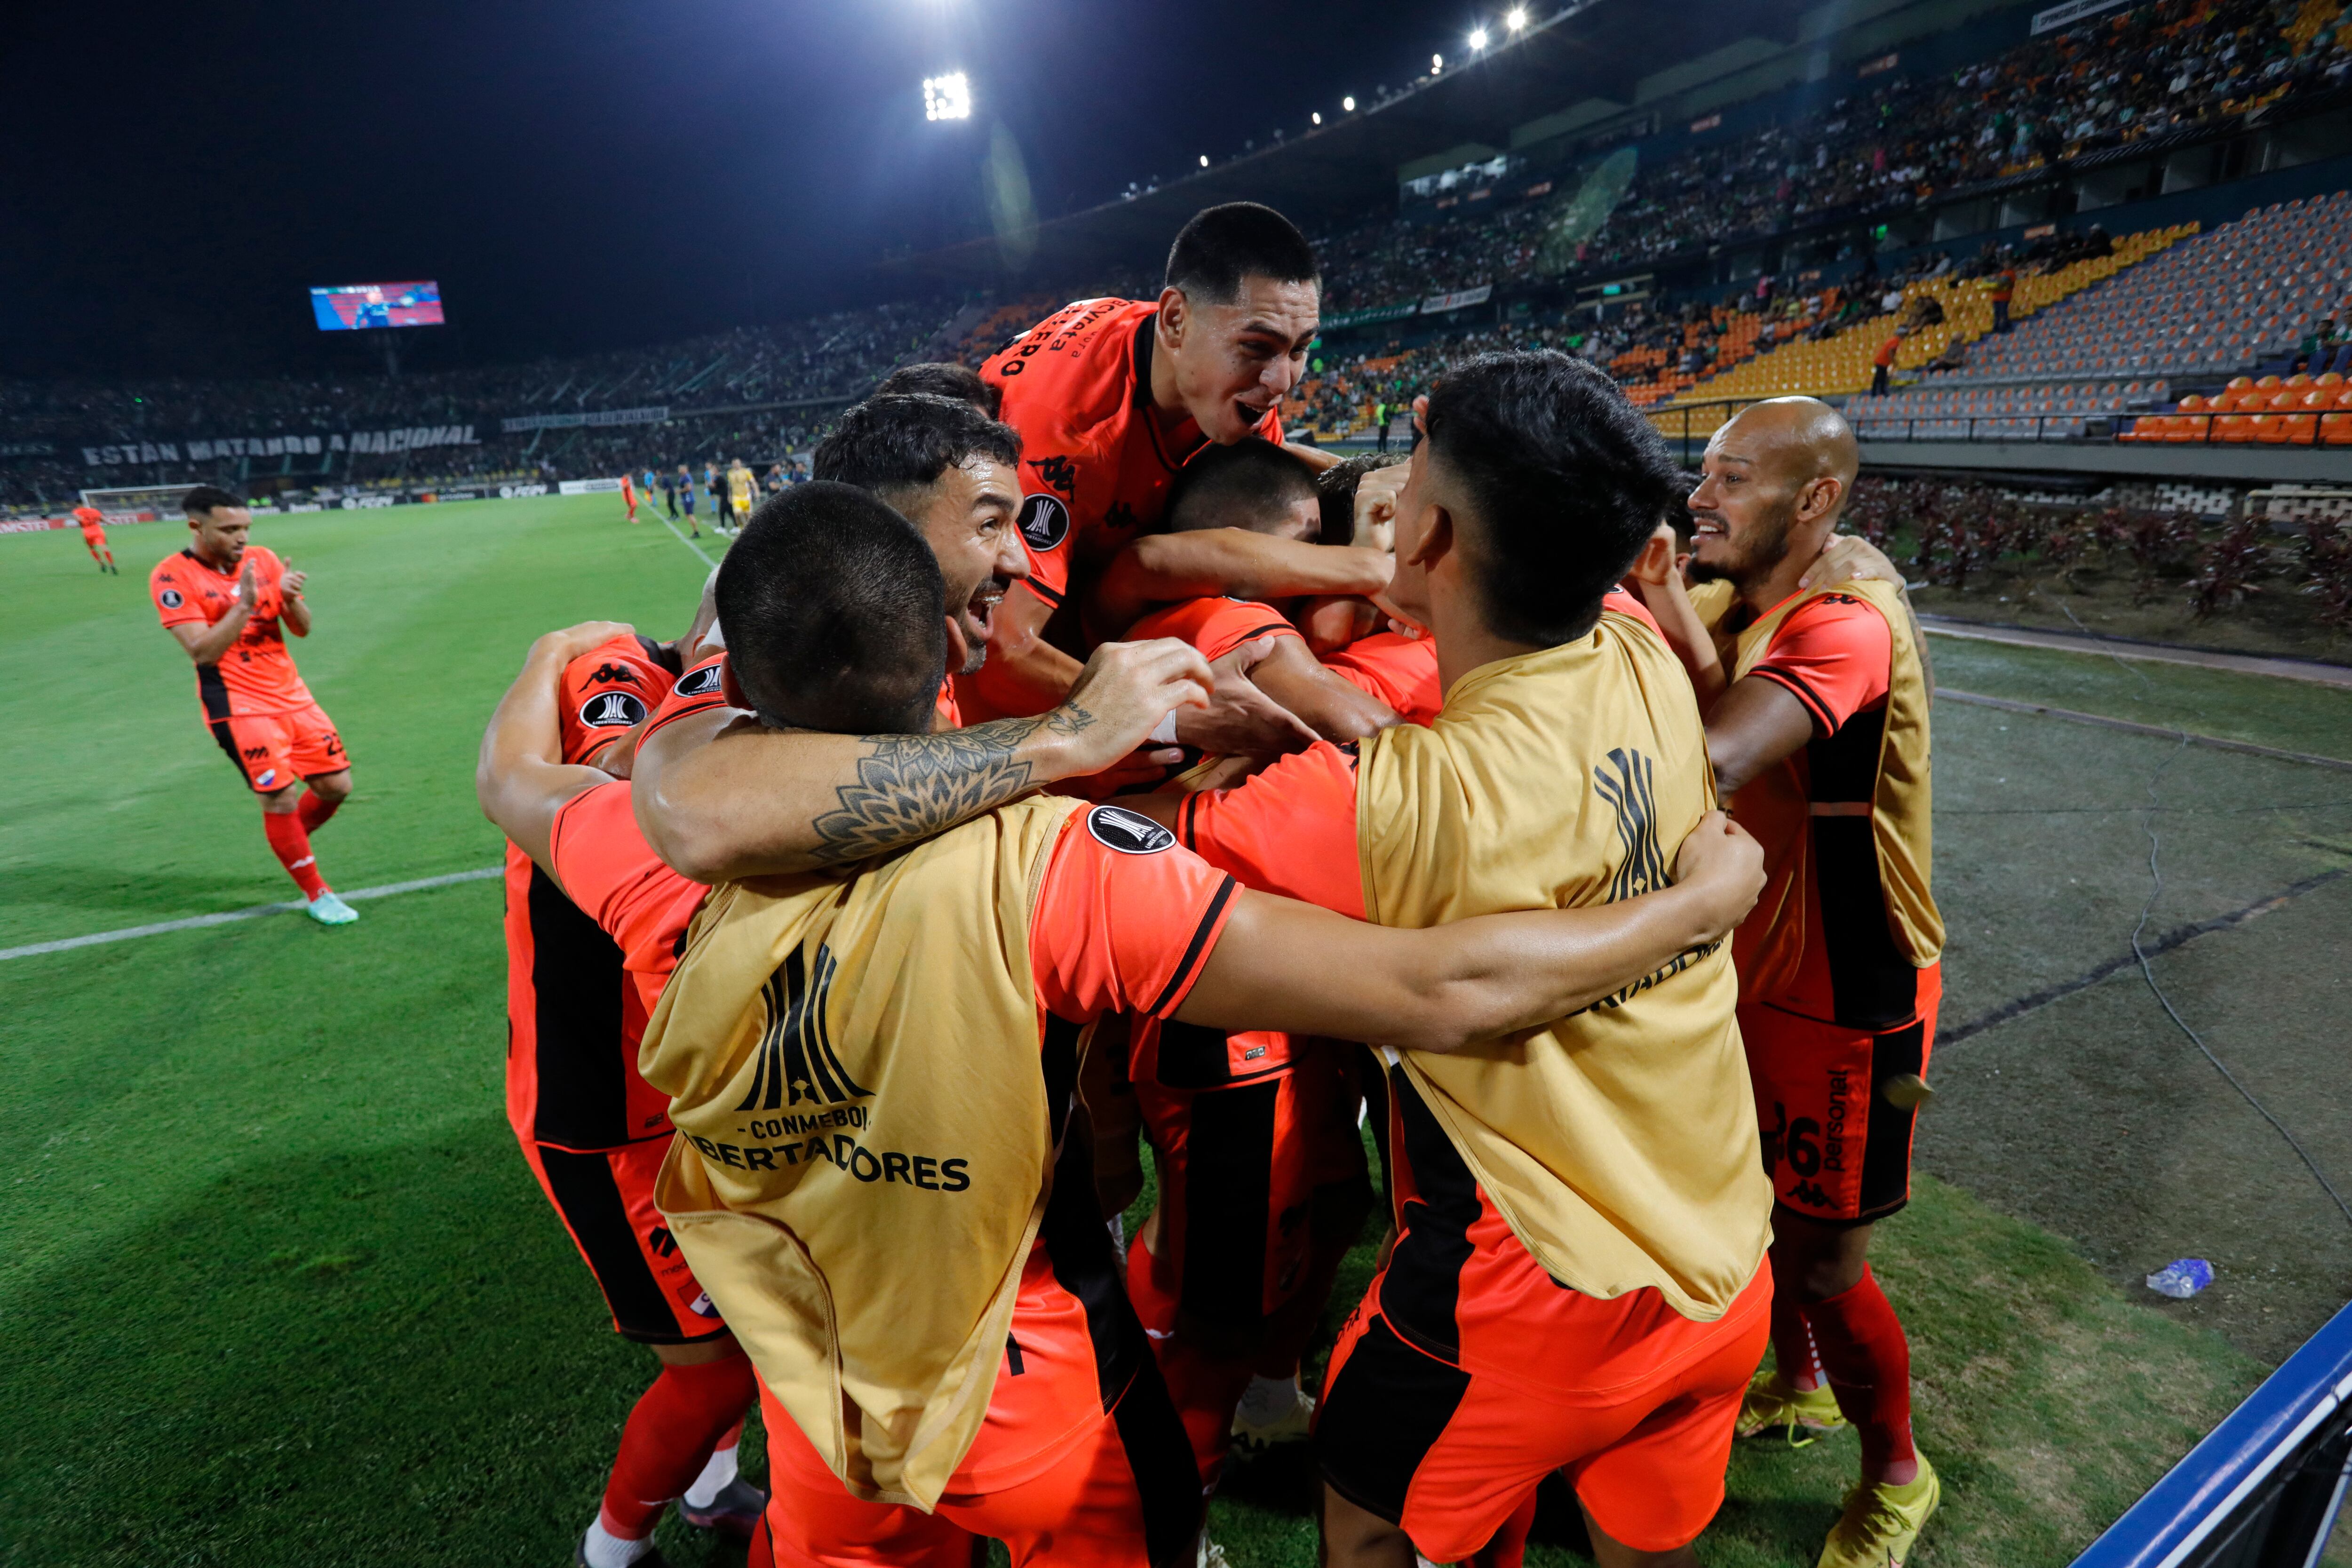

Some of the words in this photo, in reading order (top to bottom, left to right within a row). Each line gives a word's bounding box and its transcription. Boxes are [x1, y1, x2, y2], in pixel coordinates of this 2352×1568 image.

[330, 434, 345, 451] A
[349, 425, 482, 454] NACIONAL
[1144, 829, 1167, 849] LIBERTADORES
[1824, 1069, 1849, 1172] personal
[683, 1129, 970, 1192] BERTADORES
